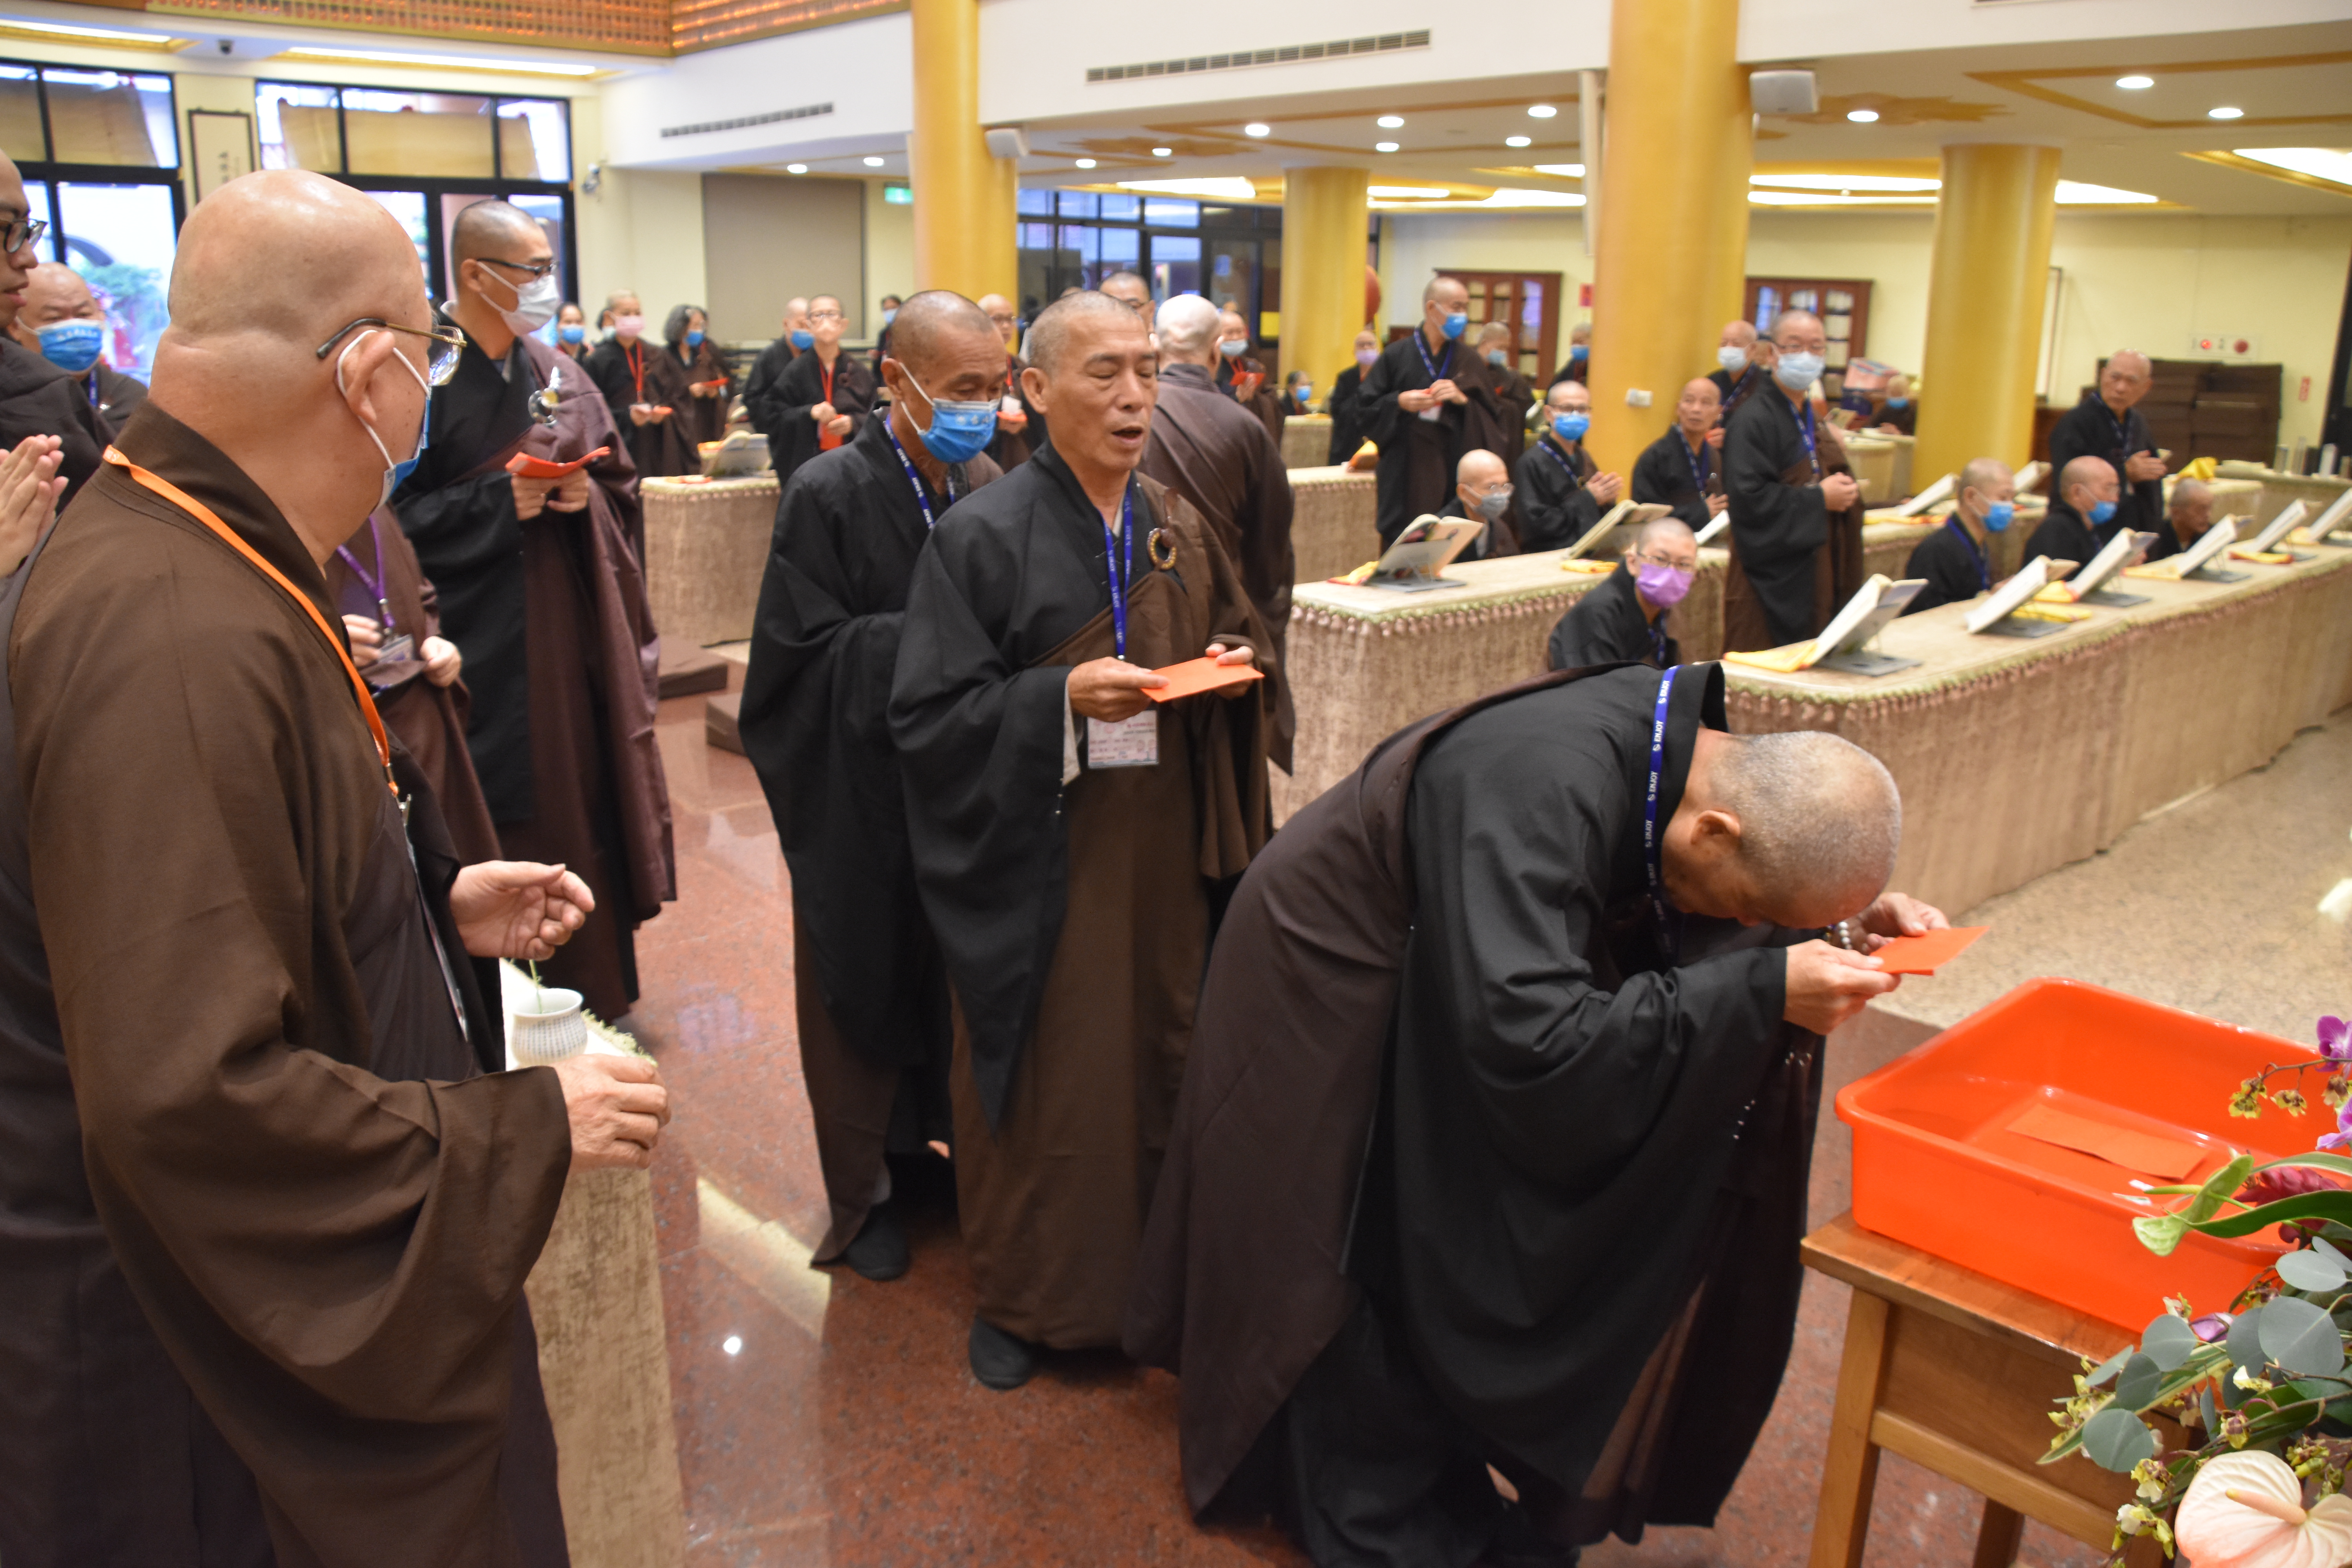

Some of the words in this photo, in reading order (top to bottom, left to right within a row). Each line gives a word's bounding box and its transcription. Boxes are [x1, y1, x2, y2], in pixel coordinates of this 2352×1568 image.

[1660, 681, 1670, 697] ENJOY
[1654, 720, 1664, 742] ENJOY
[1649, 771, 1658, 793] ENJOY
[1645, 820, 1653, 840] ENJOY
